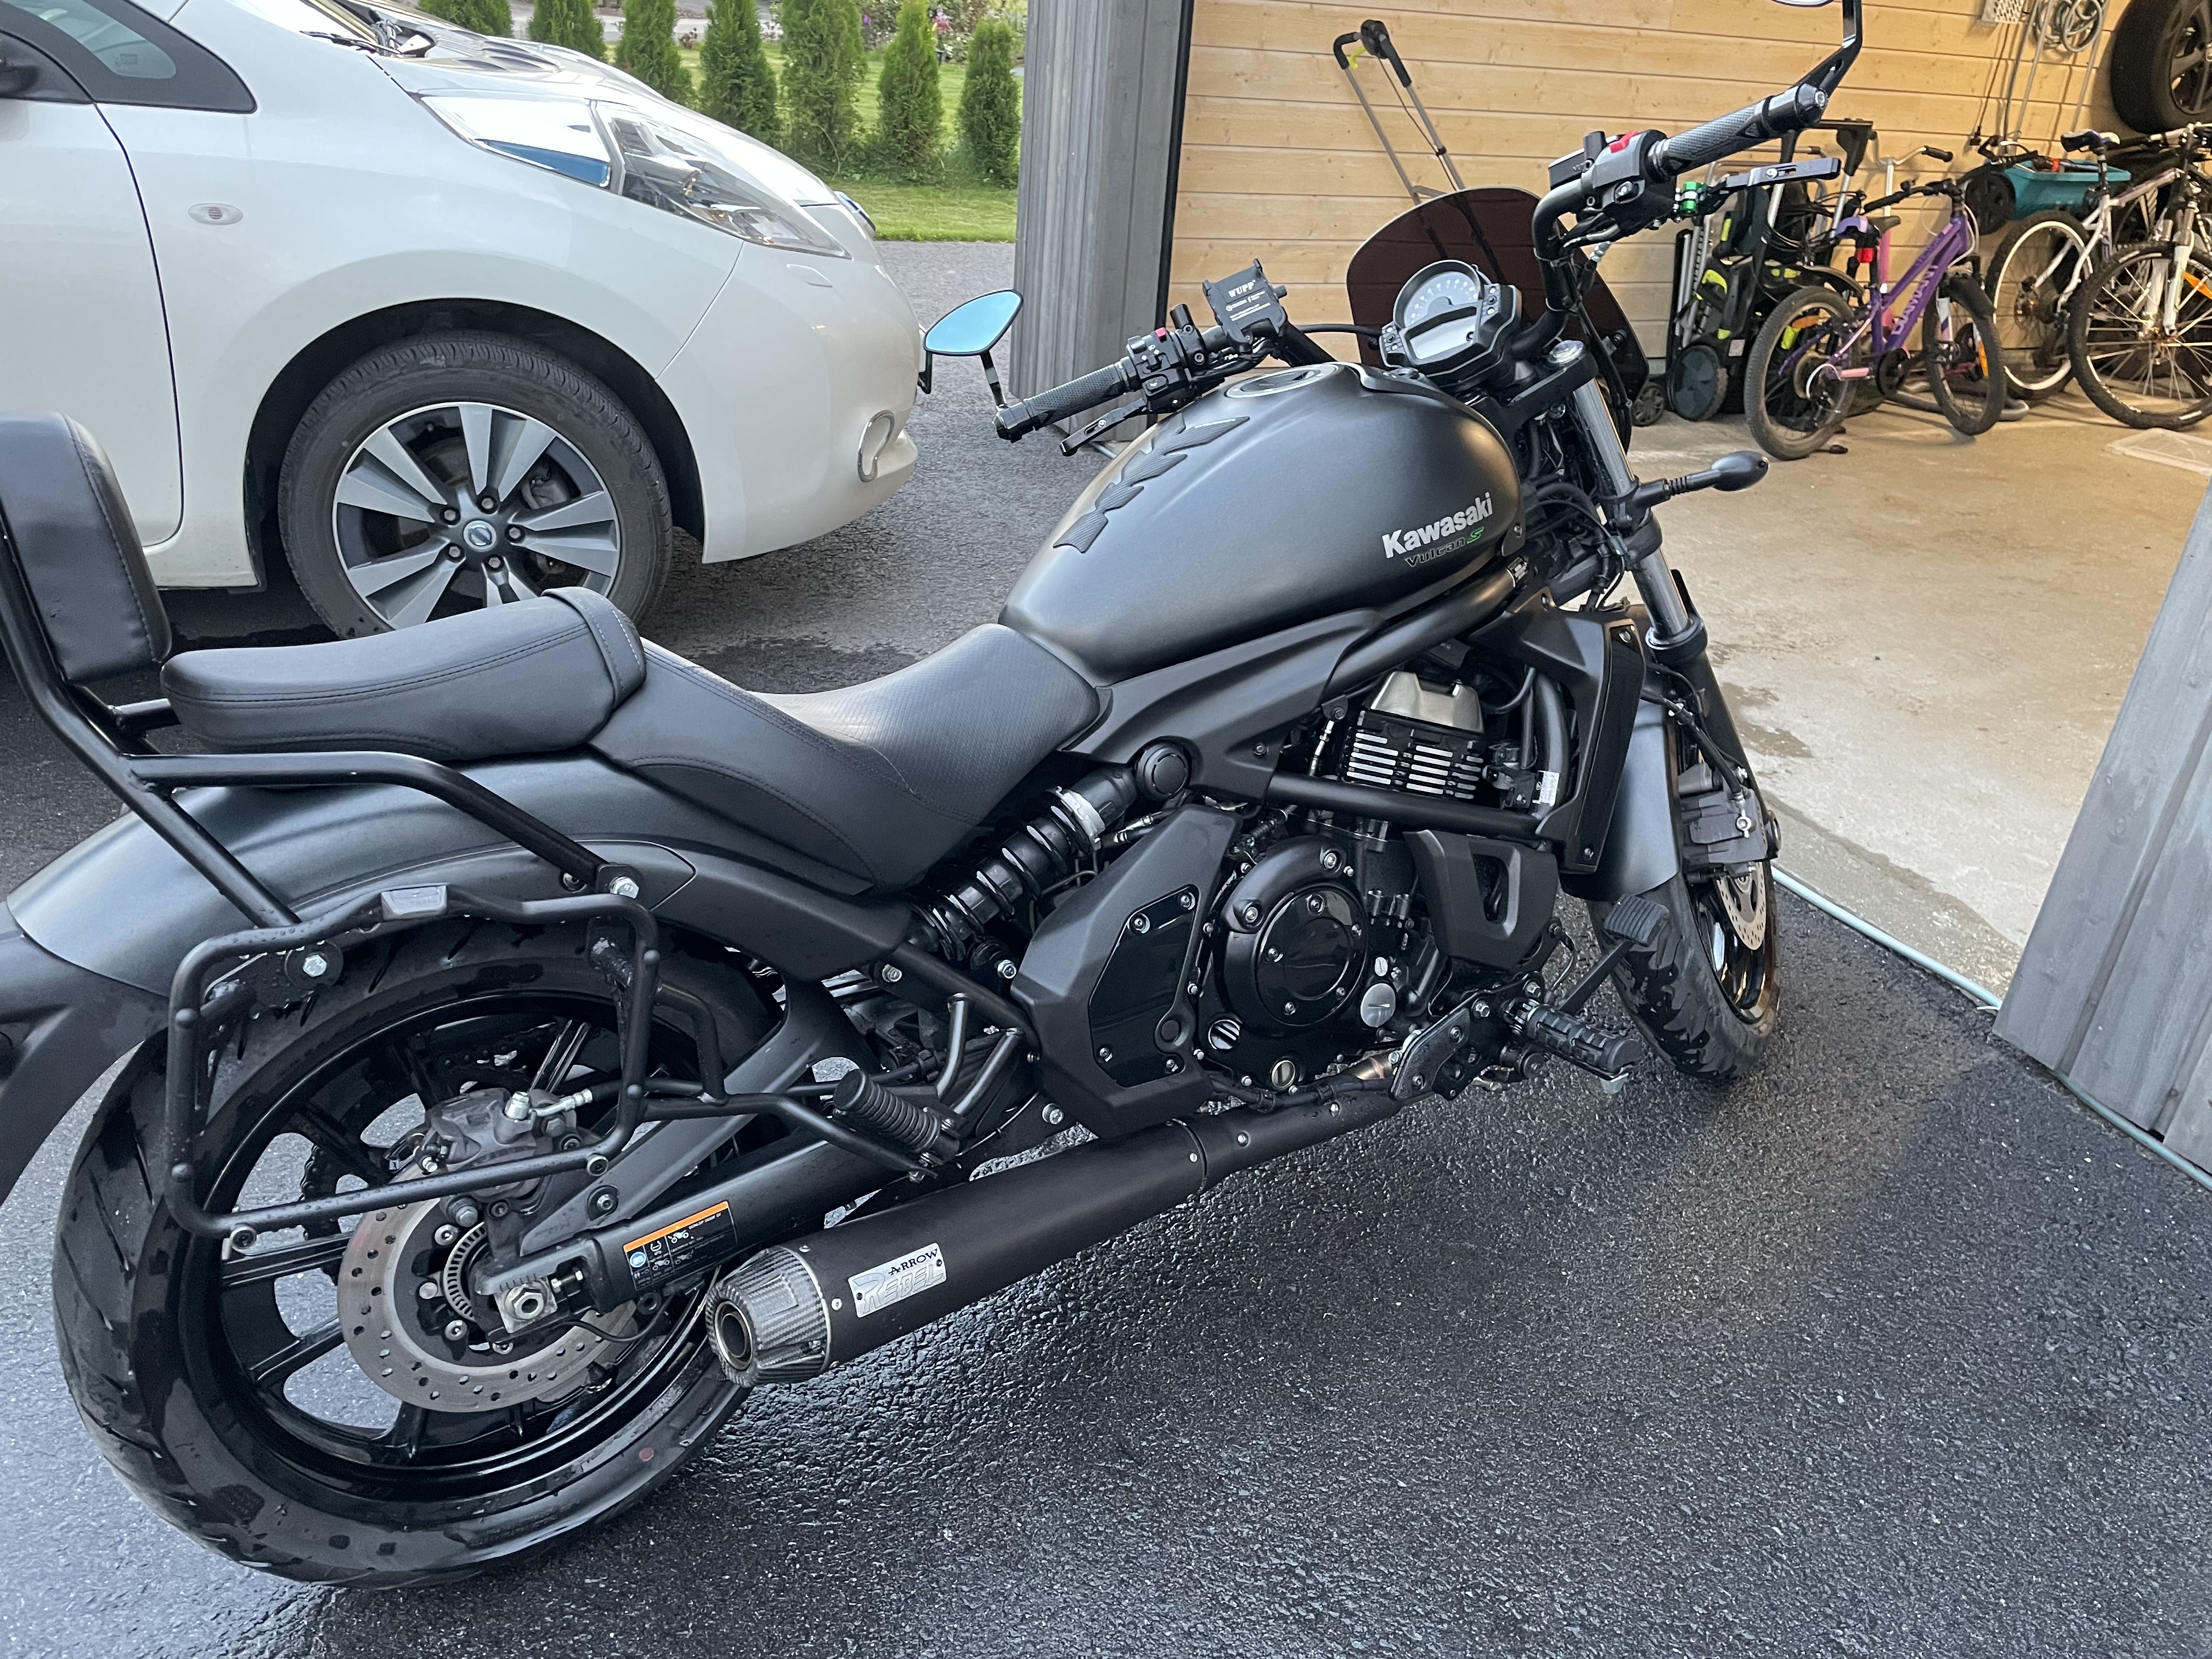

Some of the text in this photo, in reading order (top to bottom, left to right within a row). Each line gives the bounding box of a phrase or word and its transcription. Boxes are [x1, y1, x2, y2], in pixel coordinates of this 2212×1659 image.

[1228, 281, 1254, 297] WUPP
[1382, 492, 1493, 558] Kawasaki
[1466, 526, 1485, 544] S
[888, 1249, 938, 1276] ARROW
[853, 1265, 944, 1314] REBEL
